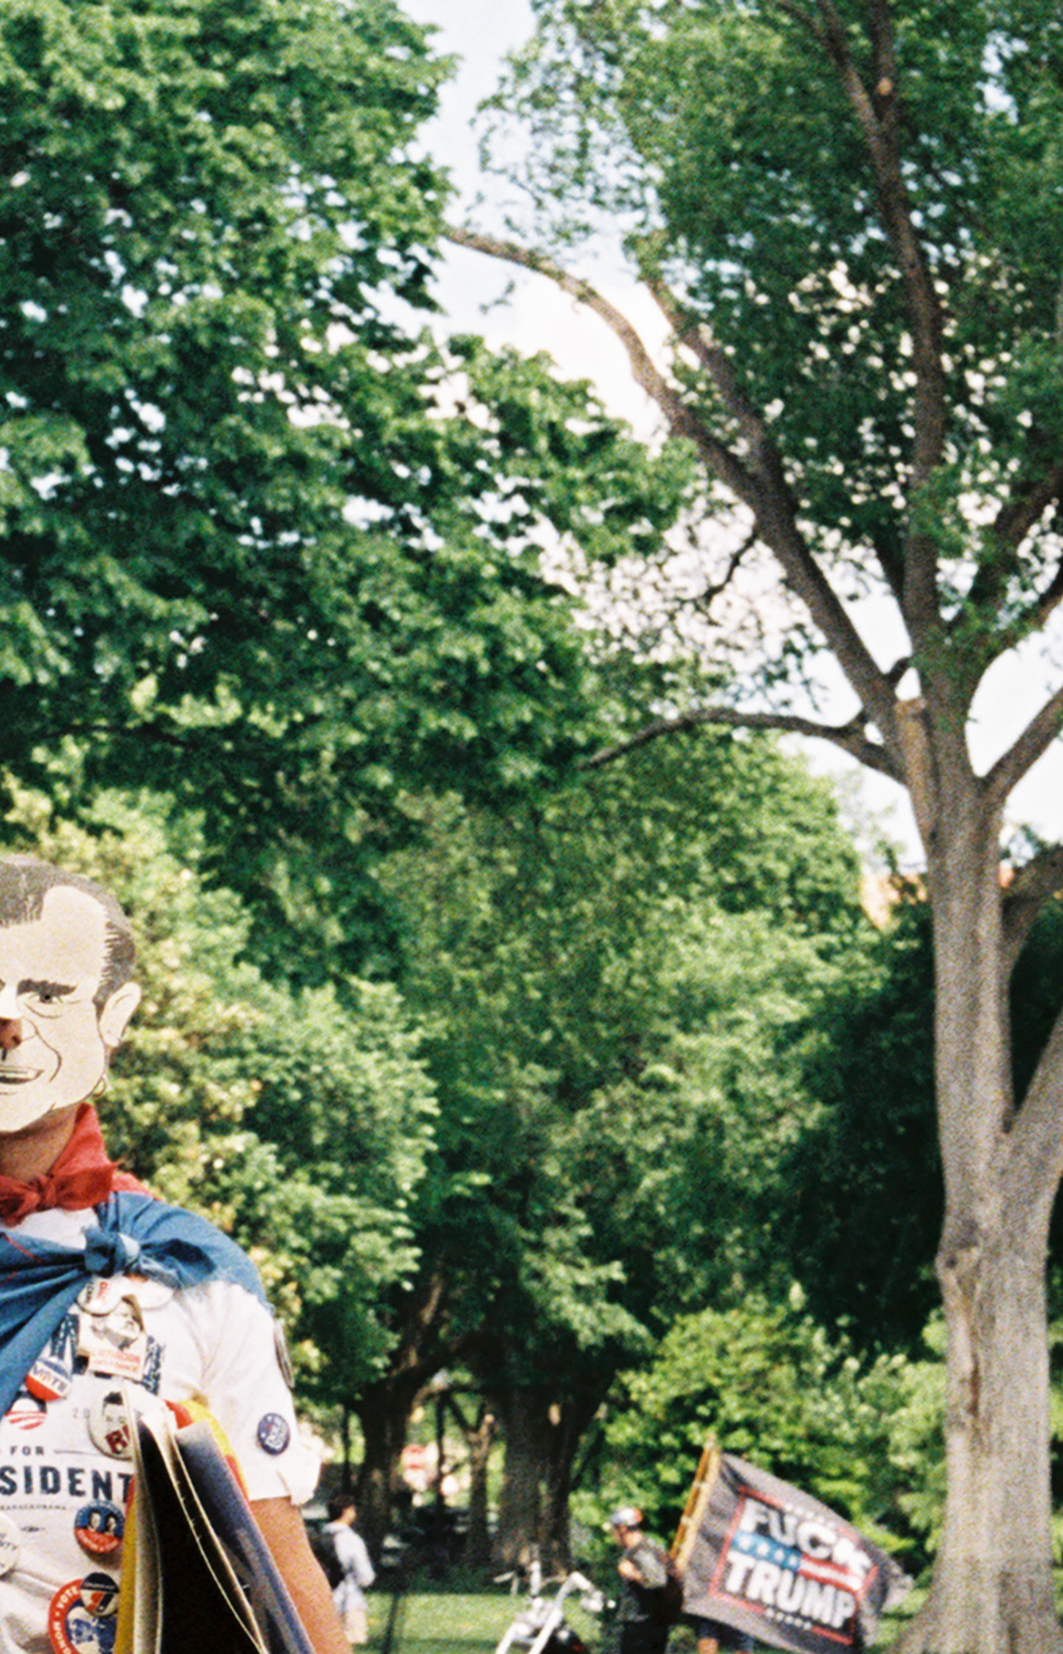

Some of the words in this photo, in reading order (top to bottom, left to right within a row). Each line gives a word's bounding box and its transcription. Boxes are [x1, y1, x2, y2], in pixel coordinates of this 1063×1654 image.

[10, 1445, 45, 1456] FOR
[56, 1584, 80, 1609] VOTE
[725, 1550, 858, 1628] TRUMP
